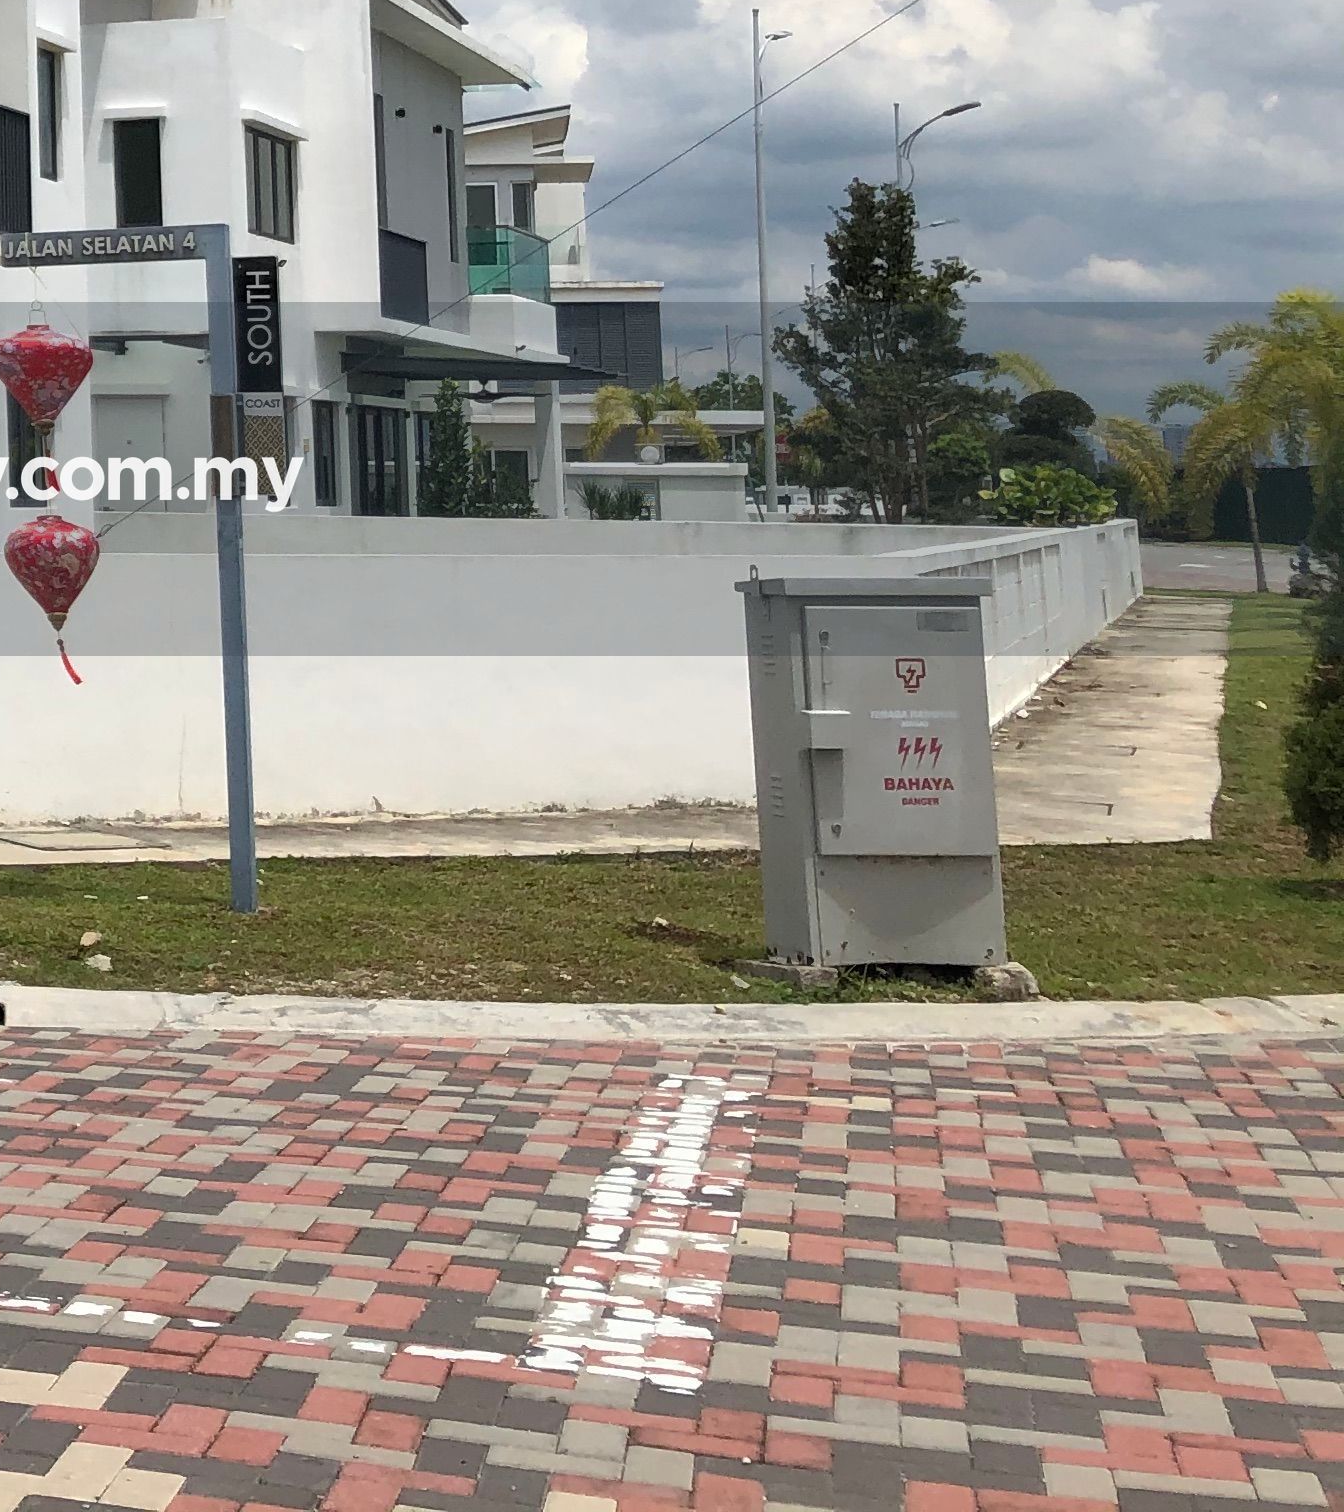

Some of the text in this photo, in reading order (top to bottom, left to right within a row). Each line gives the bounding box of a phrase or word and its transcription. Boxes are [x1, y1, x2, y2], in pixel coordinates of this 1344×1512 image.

[4, 231, 196, 259] JALAN SELATAN 4
[245, 270, 273, 366] SOUTH
[245, 399, 280, 408] COAST
[884, 777, 955, 791] BAHAYA
[902, 797, 940, 806] DANGER
